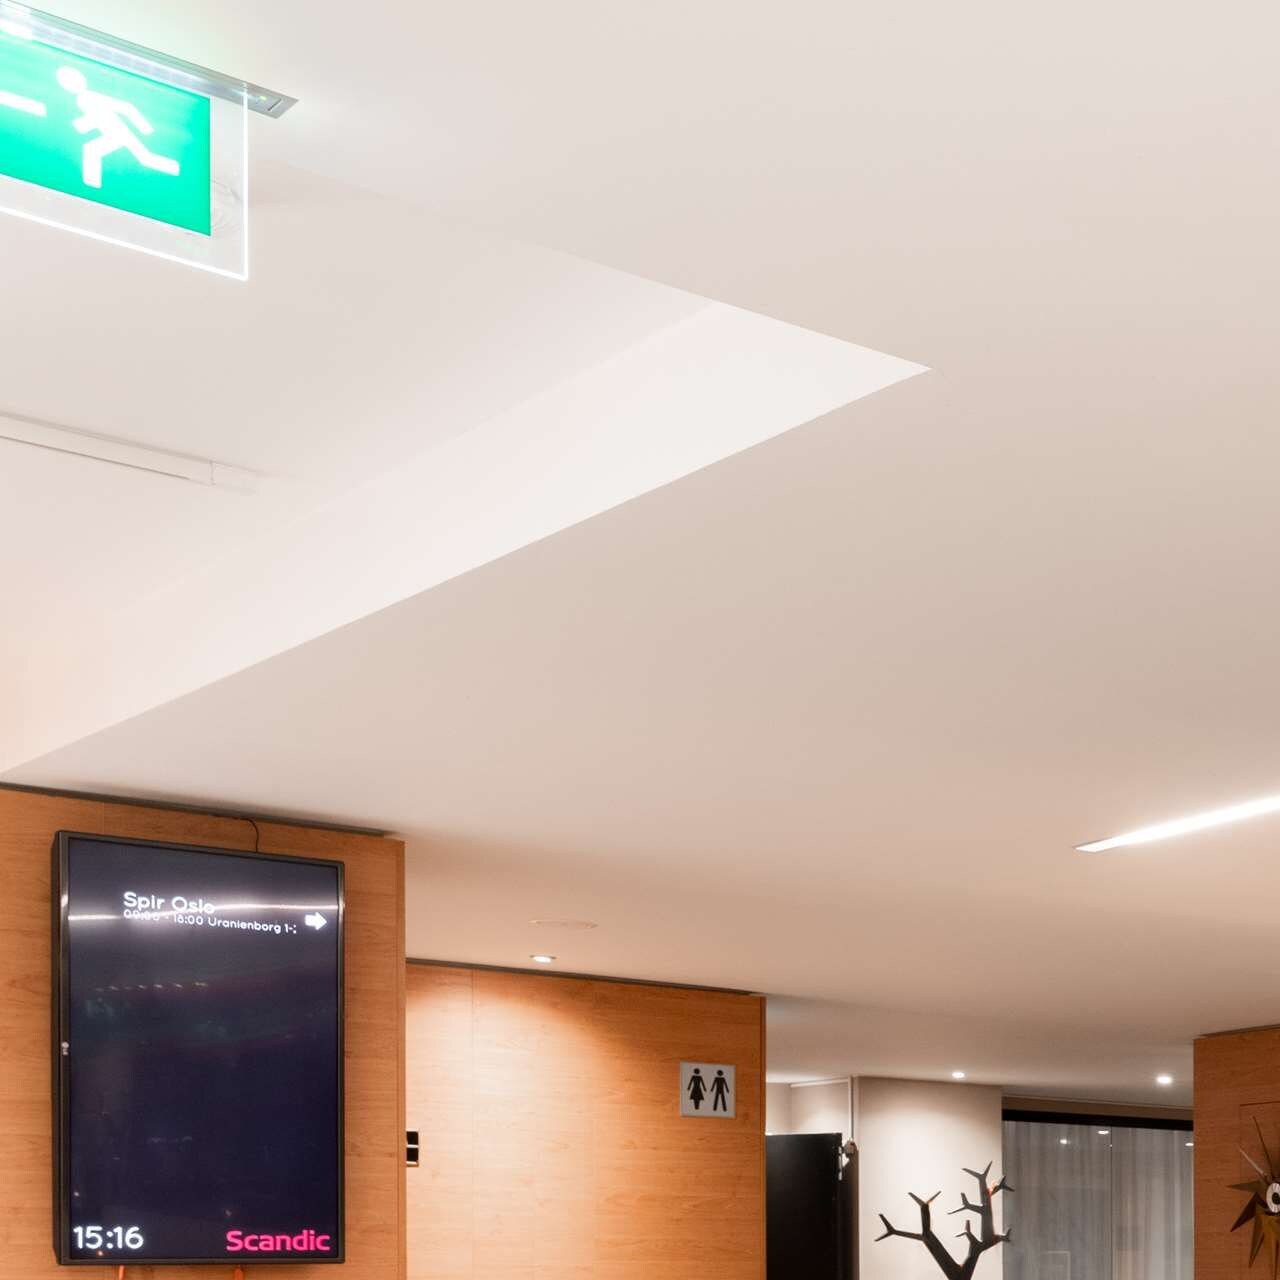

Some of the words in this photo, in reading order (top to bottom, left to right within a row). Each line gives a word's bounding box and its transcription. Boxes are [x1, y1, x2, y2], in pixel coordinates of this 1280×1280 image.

[123, 891, 165, 911] Spir
[172, 896, 216, 914] Oslo
[207, 917, 282, 935] Uranienborg
[73, 1225, 144, 1249] 15:16
[226, 1230, 330, 1251] Scandic
